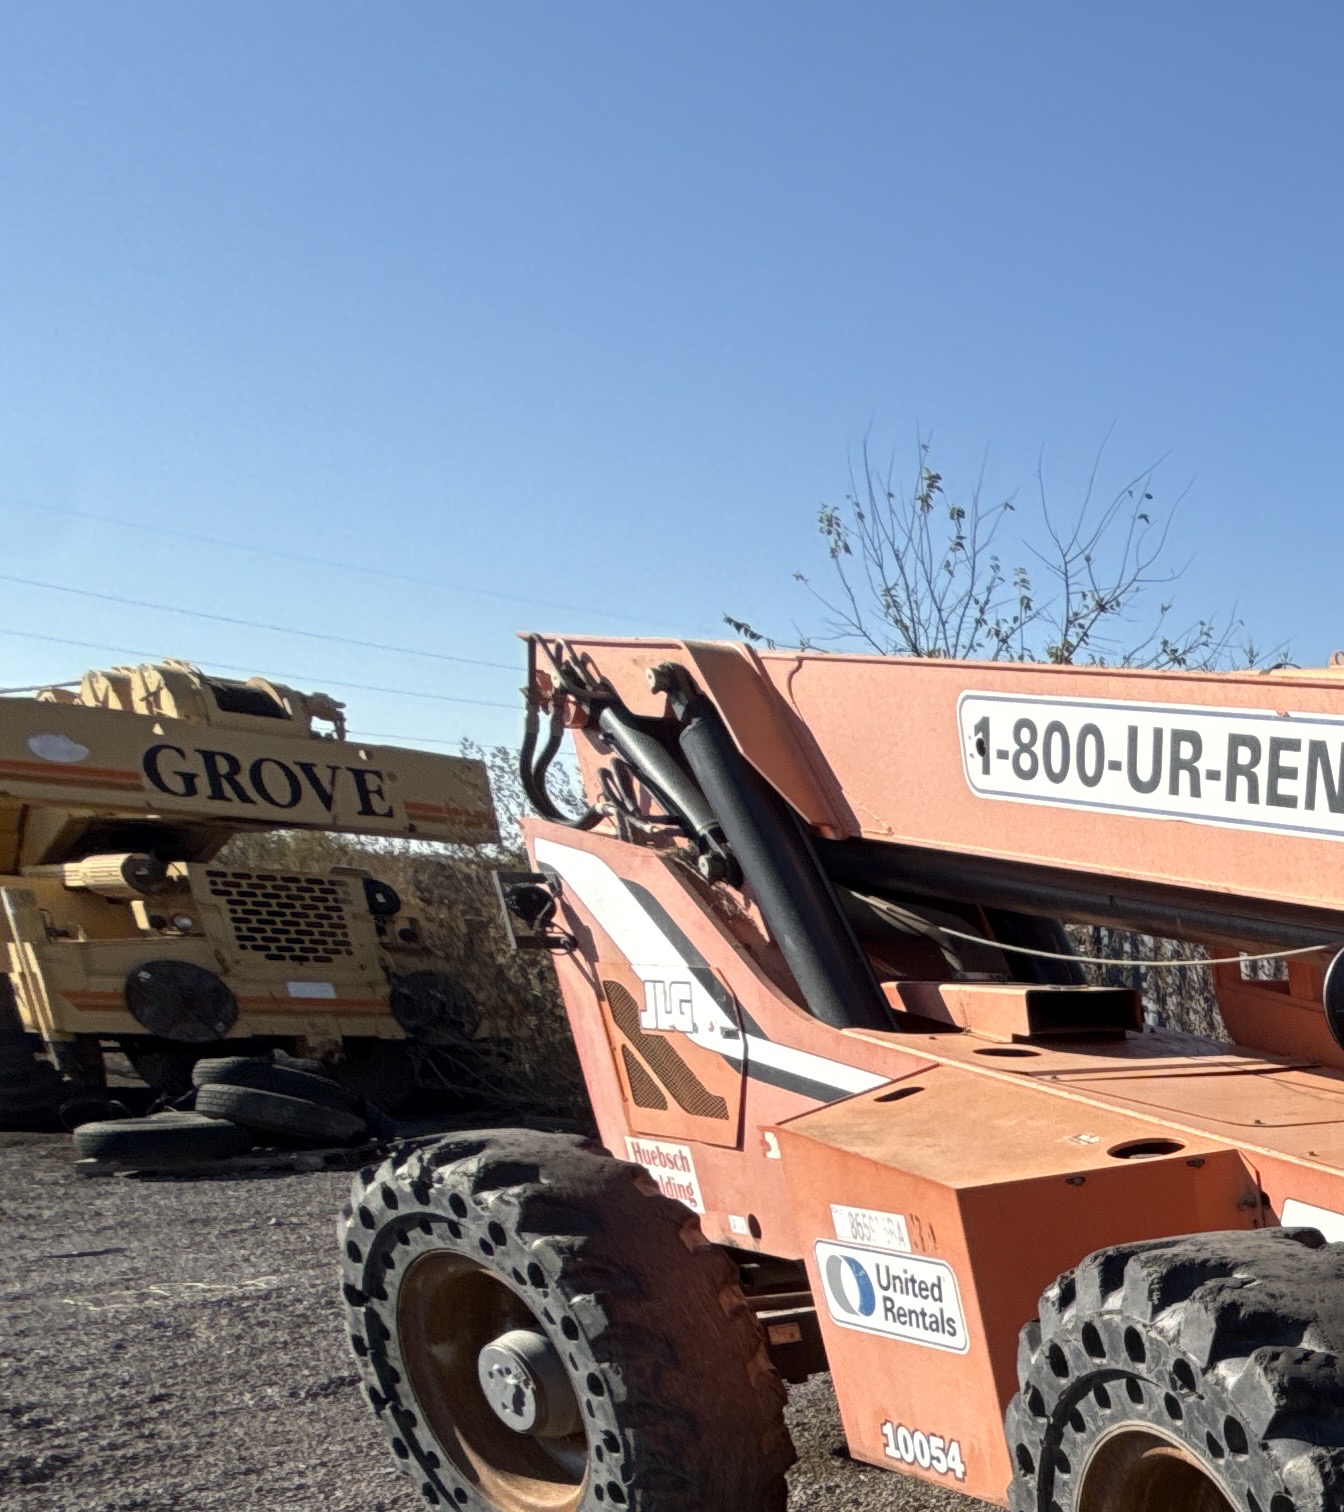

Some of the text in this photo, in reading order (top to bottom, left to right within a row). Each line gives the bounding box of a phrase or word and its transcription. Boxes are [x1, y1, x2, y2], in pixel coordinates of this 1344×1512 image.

[142, 744, 394, 818] GROVE
[641, 980, 694, 1034] JLG
[631, 1141, 691, 1173] Huebsch
[658, 1174, 698, 1208] lding
[875, 1263, 944, 1303] United
[882, 1295, 957, 1337] Rentals
[881, 1419, 967, 1482] 10054
